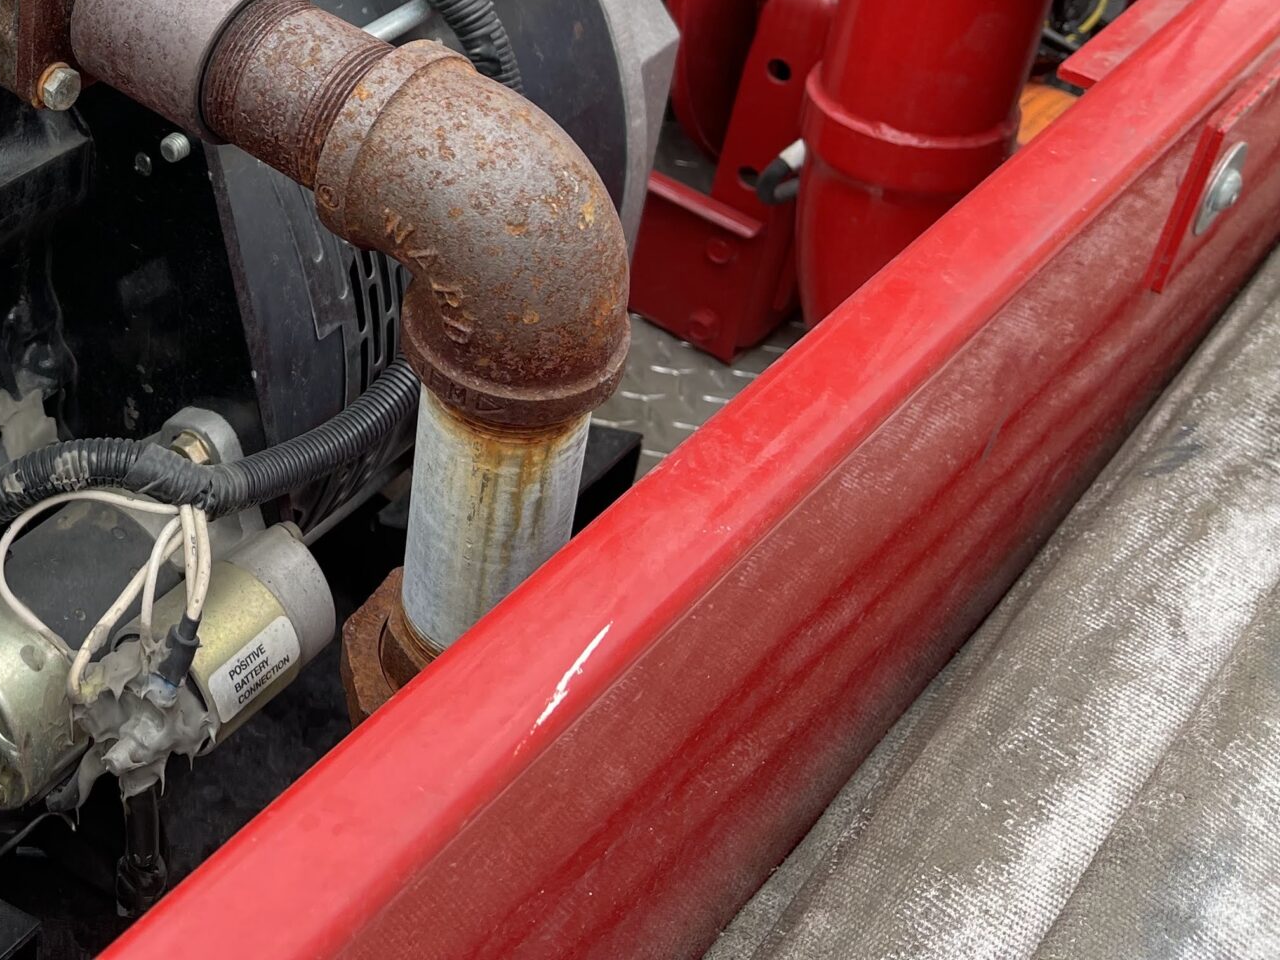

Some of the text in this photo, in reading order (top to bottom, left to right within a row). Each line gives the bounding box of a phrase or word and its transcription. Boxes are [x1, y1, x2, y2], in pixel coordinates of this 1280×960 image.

[228, 643, 266, 681] POSITIVE
[234, 657, 269, 693] BATTERY
[238, 654, 290, 704] CONNECTION
